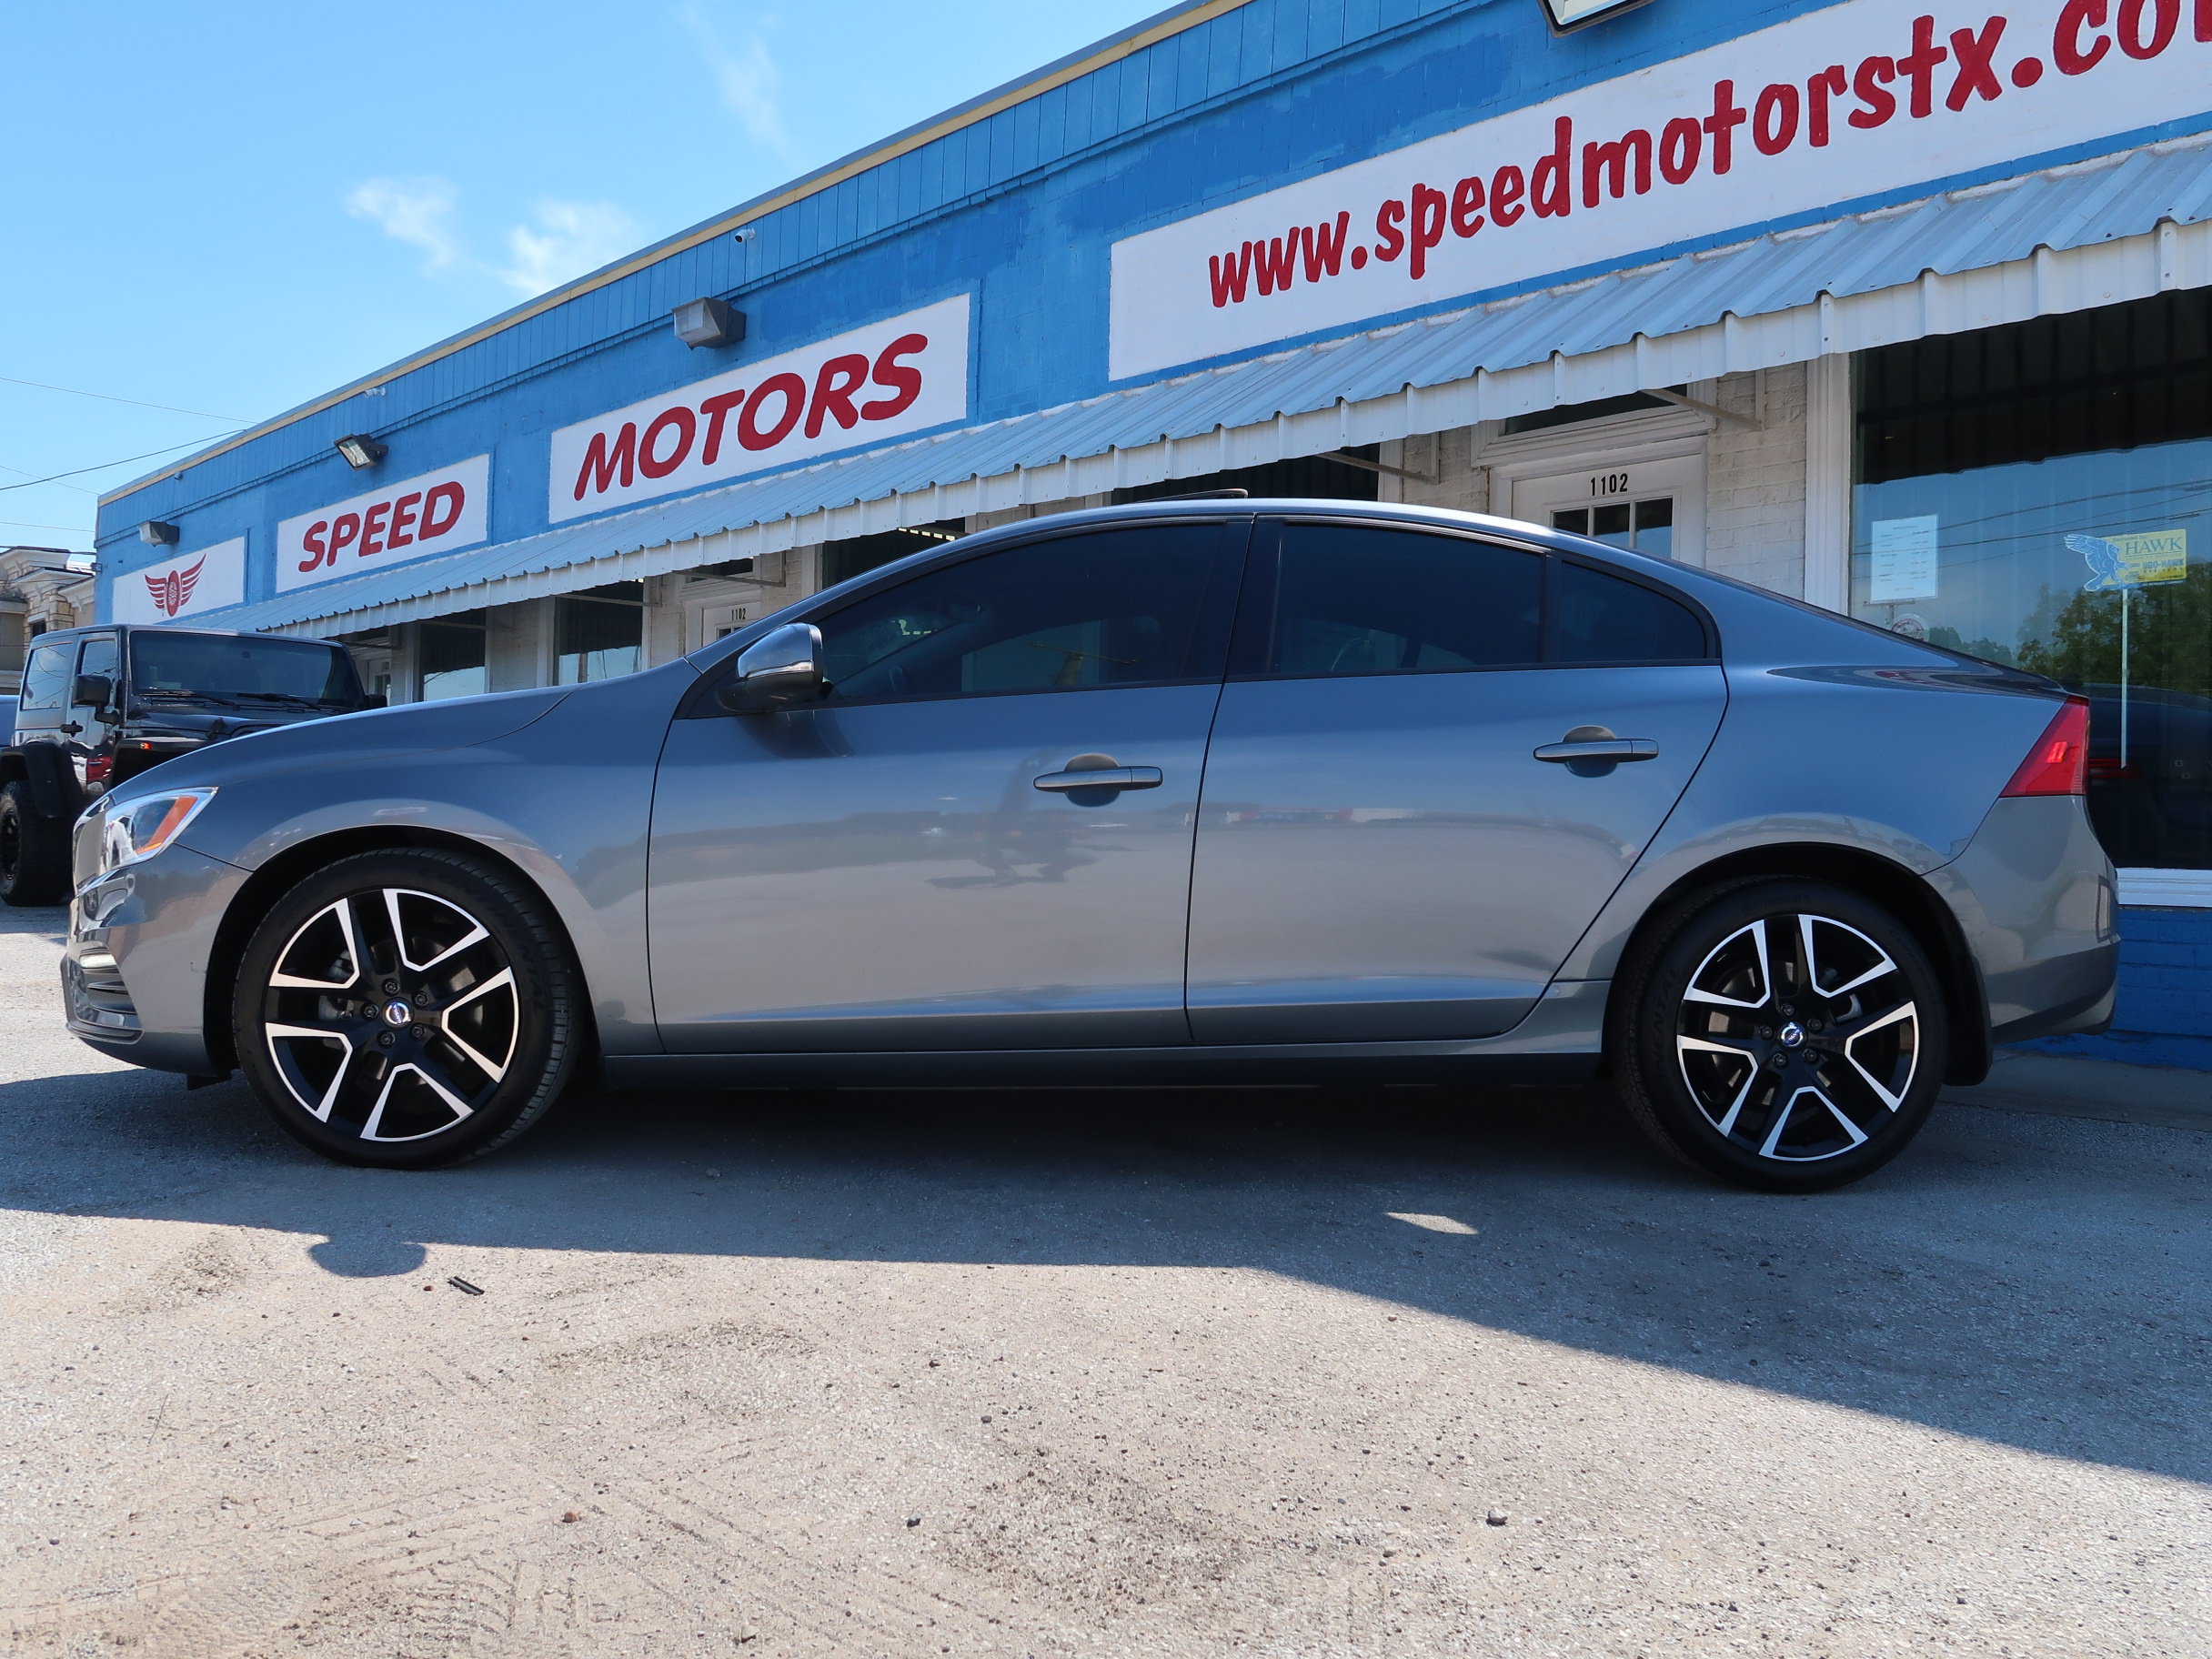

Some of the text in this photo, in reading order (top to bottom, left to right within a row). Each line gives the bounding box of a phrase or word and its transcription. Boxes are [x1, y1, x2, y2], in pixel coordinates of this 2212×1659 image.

[575, 333, 928, 499] MOTORS
[1590, 473, 1628, 496] 1102
[299, 482, 465, 571] SPEED
[2125, 536, 2184, 555] HAWK
[730, 608, 747, 621] 1102
